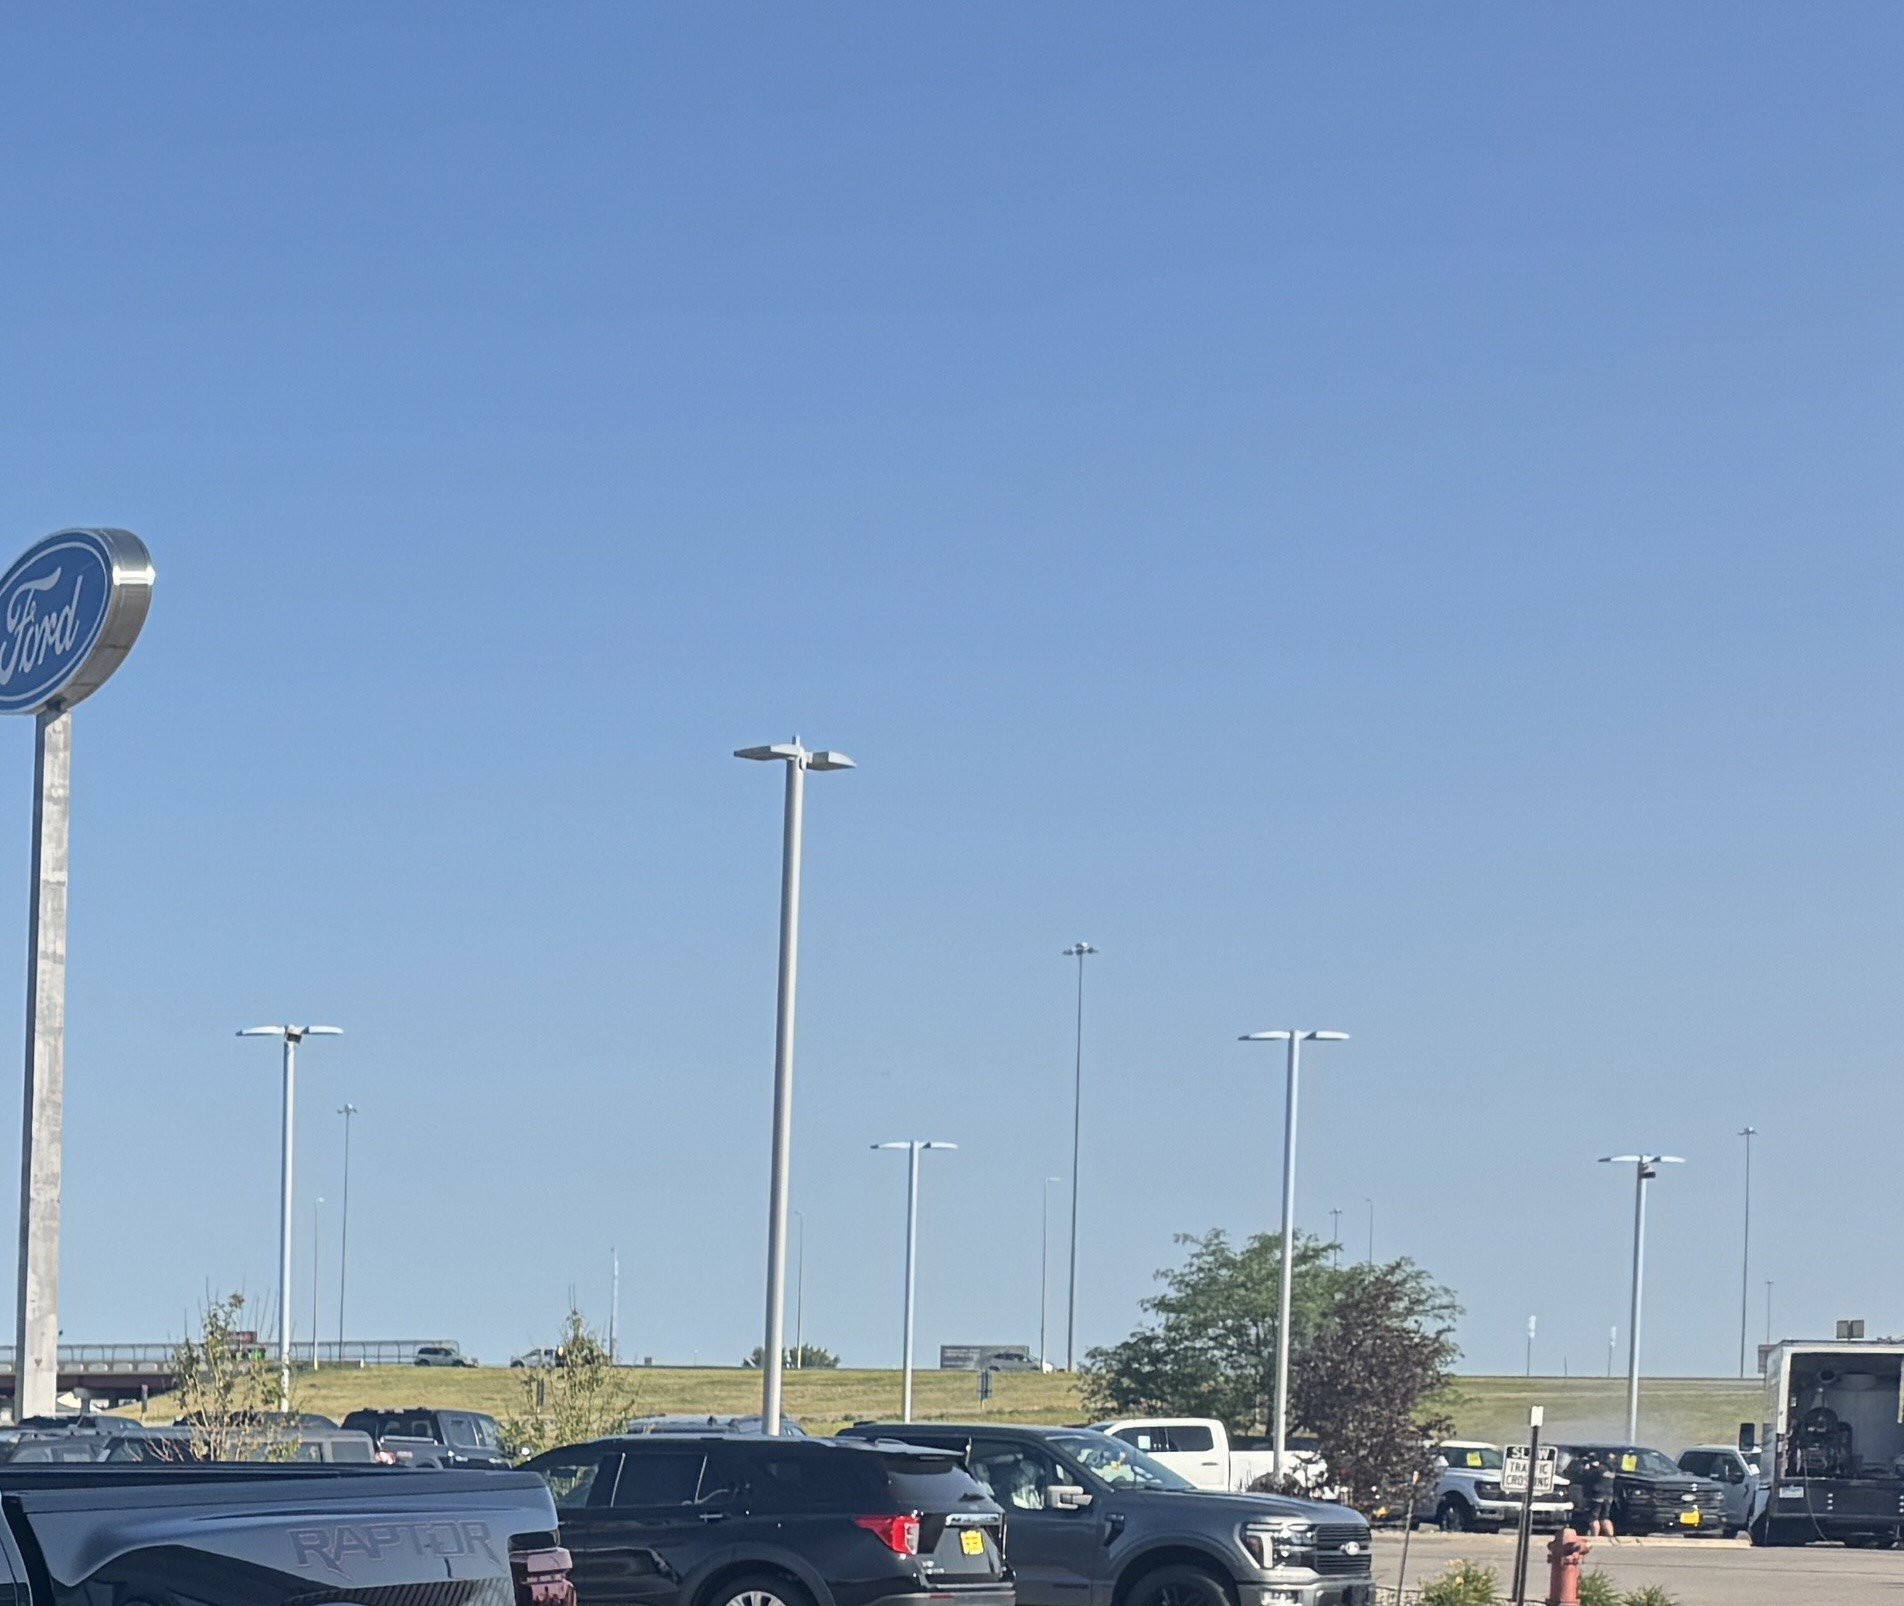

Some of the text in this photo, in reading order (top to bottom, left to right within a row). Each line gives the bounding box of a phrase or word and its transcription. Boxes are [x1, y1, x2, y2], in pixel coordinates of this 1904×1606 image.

[1511, 1447, 1550, 1460] SLW
[1510, 1462, 1548, 1475] TRAIC
[286, 1520, 507, 1581] RAPTOR
